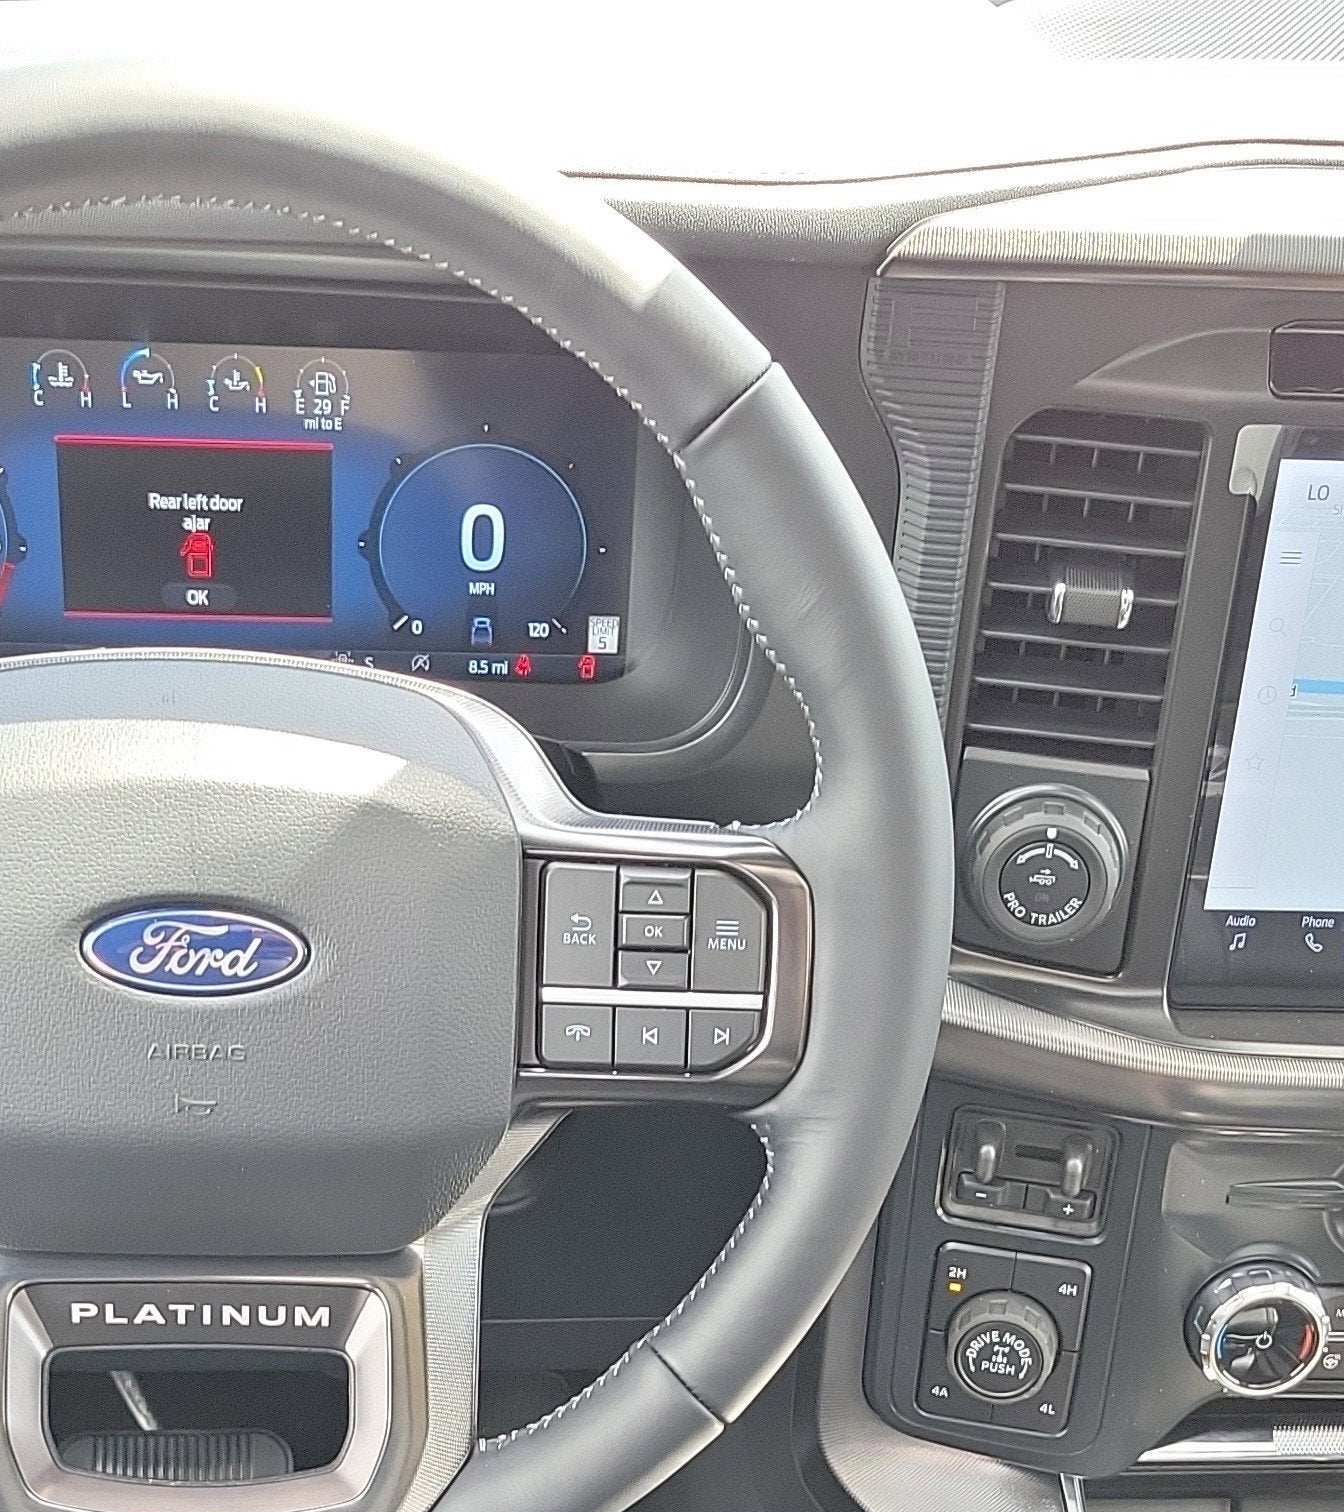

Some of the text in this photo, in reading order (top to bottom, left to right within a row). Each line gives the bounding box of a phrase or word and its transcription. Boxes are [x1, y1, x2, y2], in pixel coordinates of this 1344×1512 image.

[313, 399, 331, 415] 29
[320, 417, 333, 431] to
[334, 417, 342, 431] E
[1307, 484, 1330, 502] LO
[148, 493, 243, 512] Rear left door
[182, 514, 210, 533] ajar
[460, 503, 506, 572] 0
[469, 582, 495, 597] MPH
[186, 589, 209, 606] OK
[411, 619, 423, 635] 0
[528, 622, 549, 638] 120
[590, 618, 619, 628] SPEED
[598, 636, 607, 650] 5
[468, 660, 488, 675] 8.5
[1003, 891, 1083, 926] PRO TRAILER
[1225, 914, 1256, 928] Audio
[1301, 915, 1334, 929] Phone
[562, 933, 597, 945] BACK
[644, 925, 663, 938] OK
[128, 918, 262, 978] Ford
[707, 938, 746, 951] MENU
[147, 1042, 247, 1061] AIRBAG
[948, 1266, 967, 1280] 2H
[1058, 1283, 1078, 1297] 4H
[70, 1302, 331, 1328] PLATINUM
[965, 1330, 1033, 1366] DRIVE MODE
[981, 1360, 1016, 1376] PUSH
[931, 1384, 949, 1398] 4A
[1039, 1402, 1056, 1415] 4L
